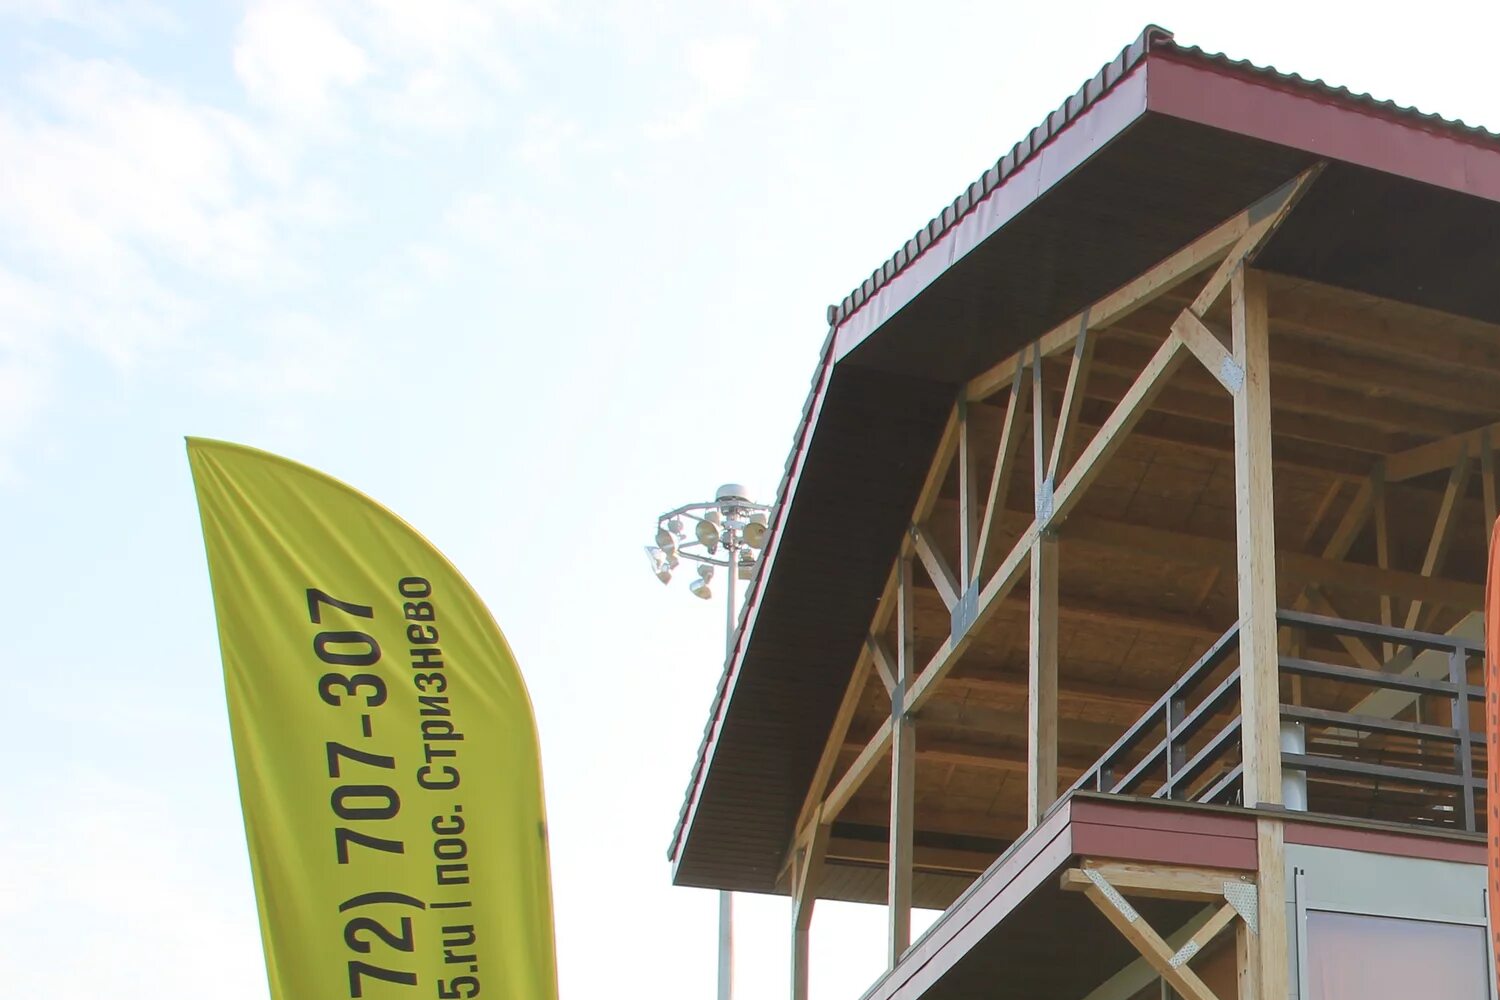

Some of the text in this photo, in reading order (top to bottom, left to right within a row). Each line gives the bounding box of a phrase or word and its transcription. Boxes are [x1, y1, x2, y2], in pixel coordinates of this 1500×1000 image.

[305, 587, 405, 865] 707-307
[398, 576, 464, 790] Стризнево
[431, 804, 470, 885] пос.
